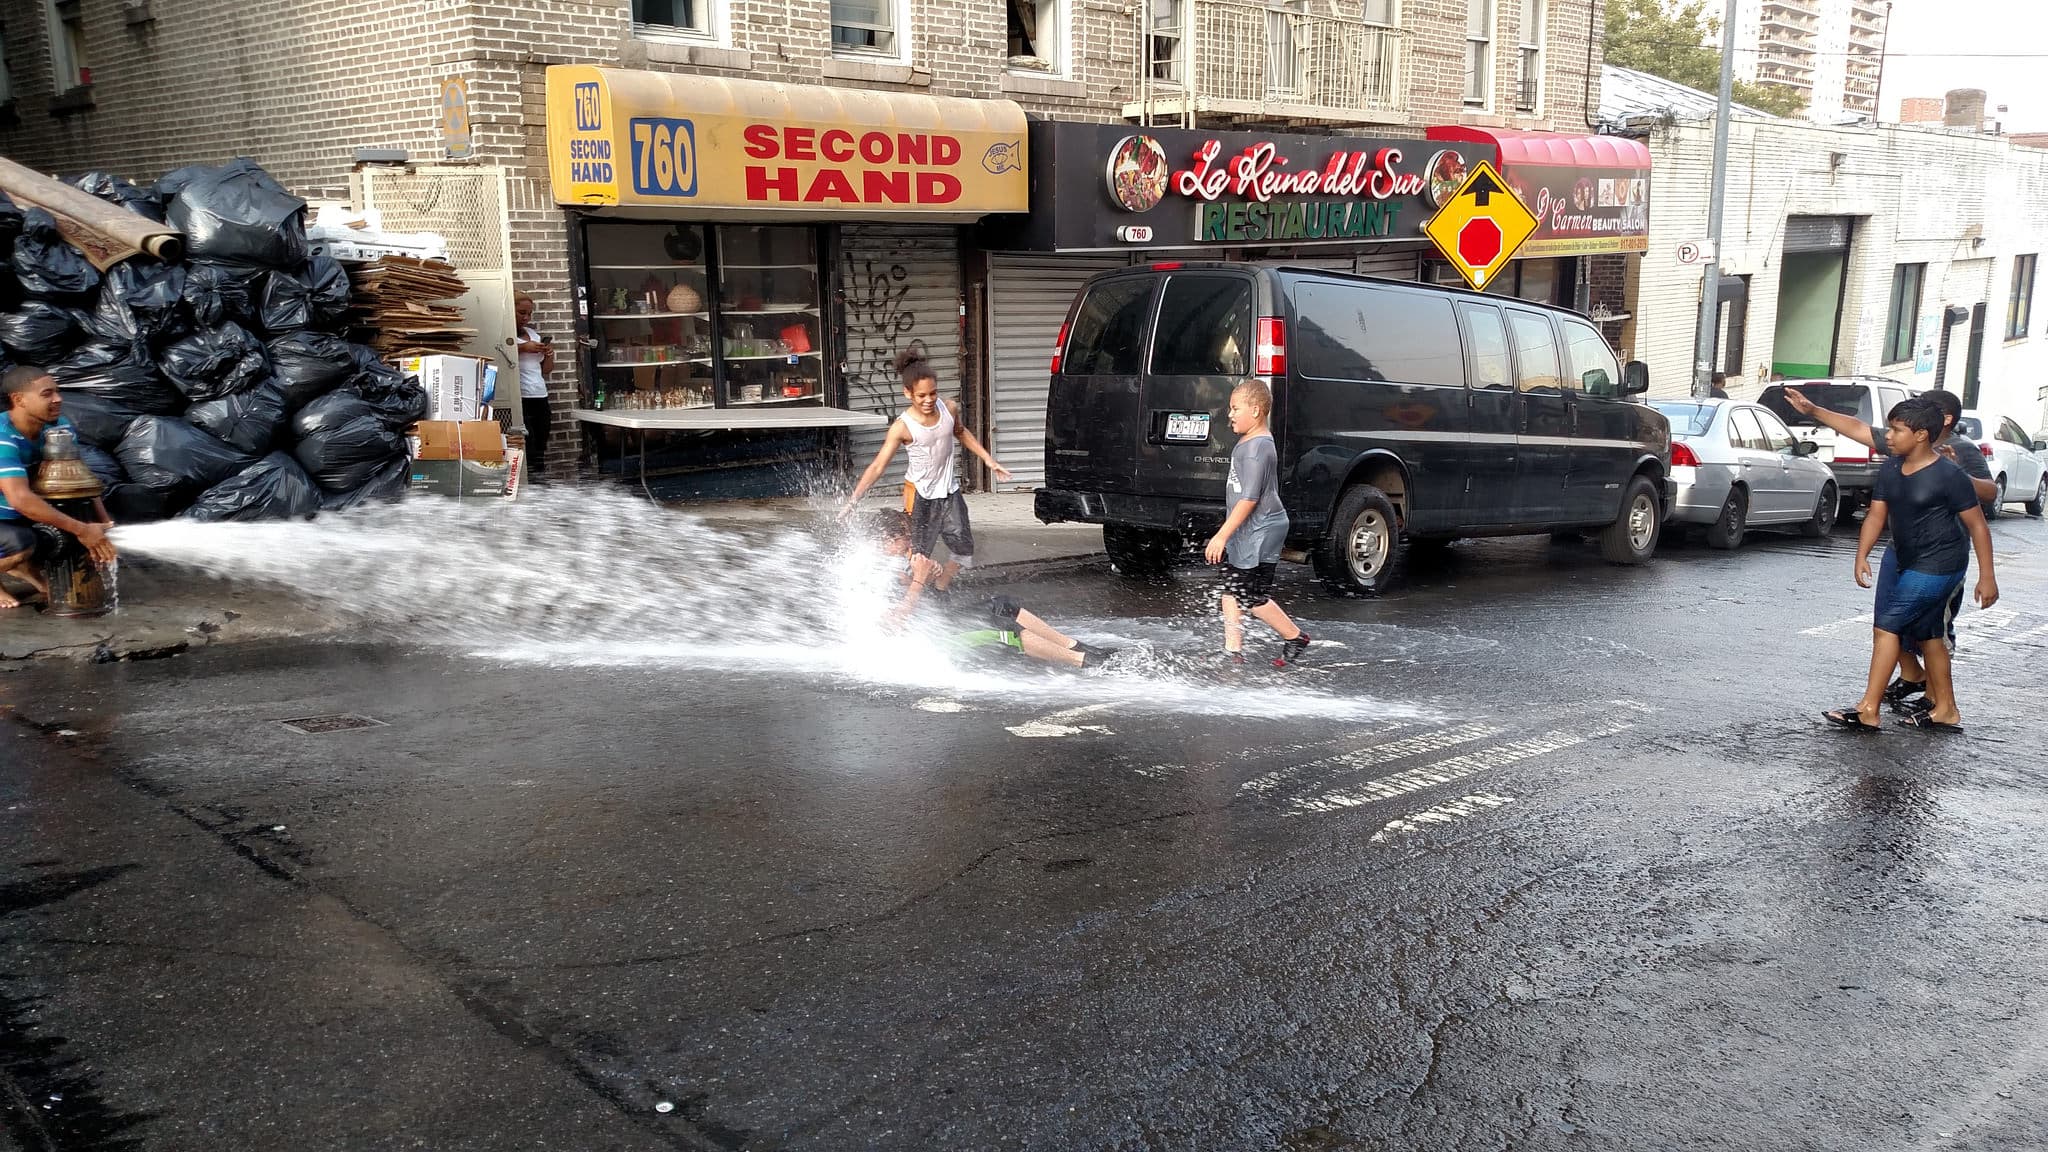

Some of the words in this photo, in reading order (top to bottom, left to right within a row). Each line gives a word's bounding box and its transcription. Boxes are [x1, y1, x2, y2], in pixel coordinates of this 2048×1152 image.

[576, 86, 600, 128] 760
[570, 139, 611, 159] SECOND
[634, 123, 693, 192] 760
[743, 124, 961, 166] SECOND
[570, 162, 613, 183] HAND
[745, 166, 962, 204] HAND
[1179, 139, 1232, 200] La
[1237, 141, 1319, 202] Reina
[1323, 150, 1368, 197] del
[1370, 147, 1426, 200] Sur
[1131, 228, 1147, 240] 760
[1200, 200, 1403, 242] RESTAURANT
[1592, 218, 1620, 231] BEAUTY
[1621, 218, 1645, 231] SALON
[1194, 456, 1231, 464] CHEVROL
